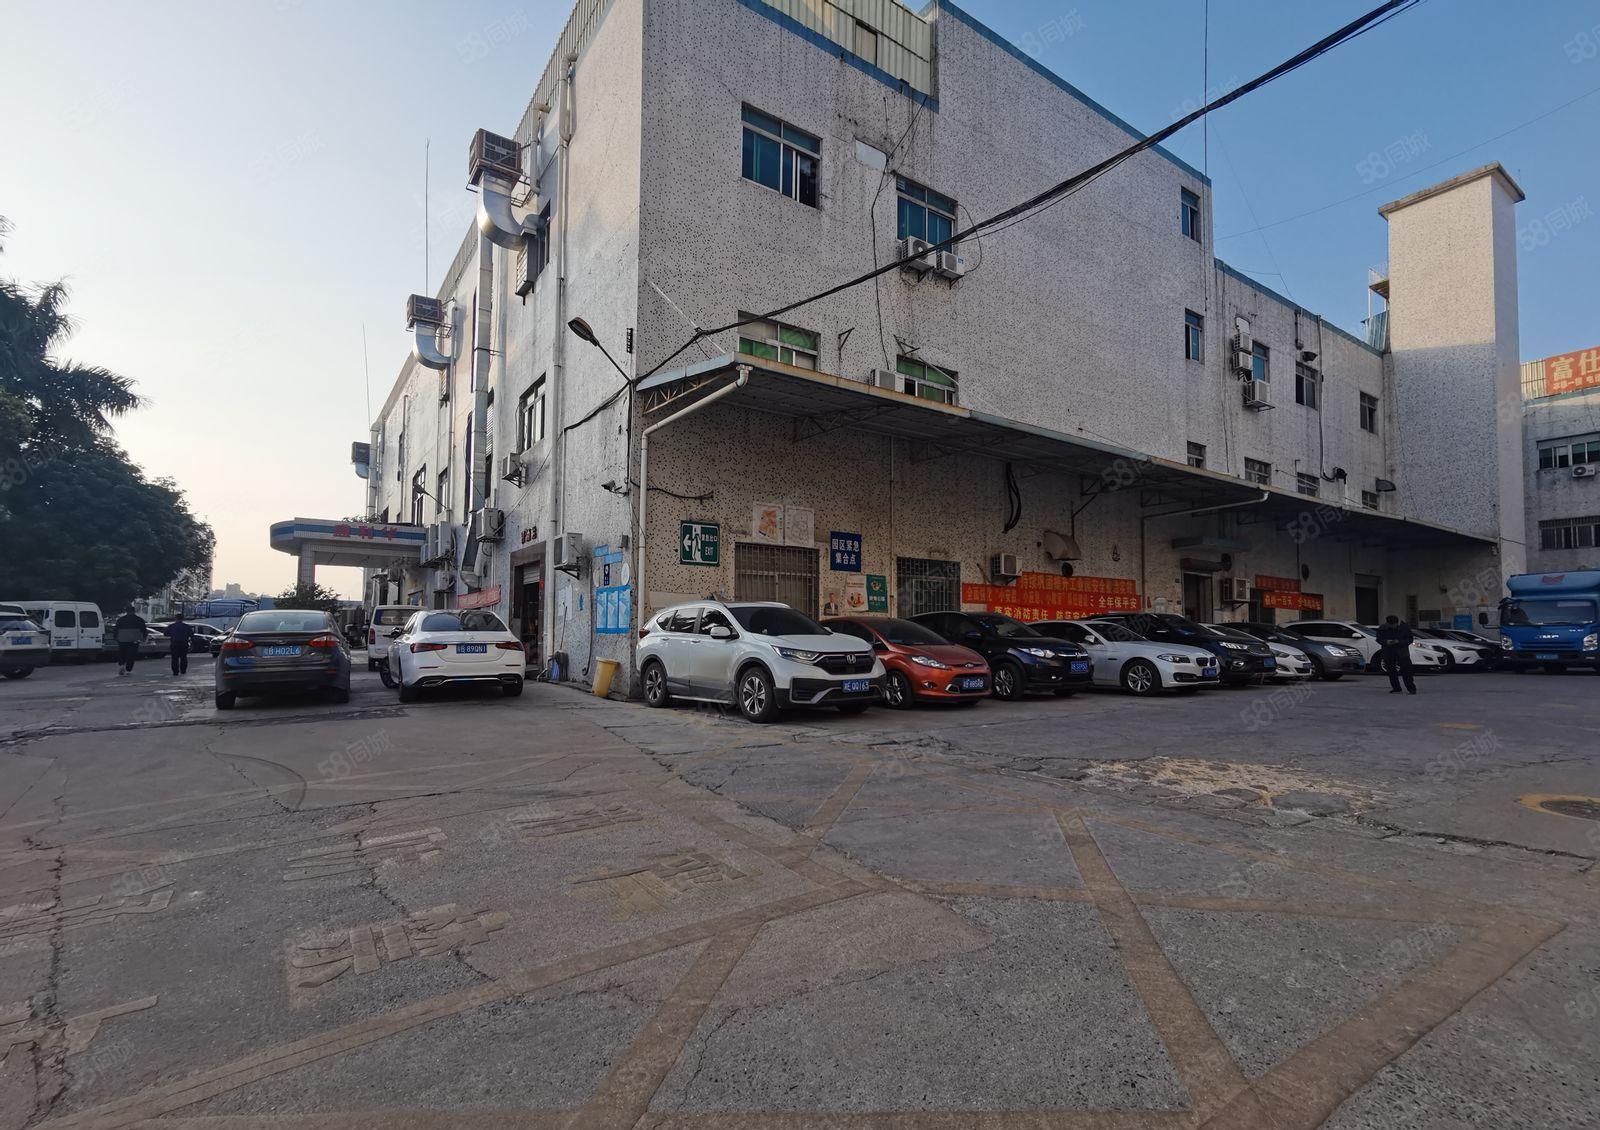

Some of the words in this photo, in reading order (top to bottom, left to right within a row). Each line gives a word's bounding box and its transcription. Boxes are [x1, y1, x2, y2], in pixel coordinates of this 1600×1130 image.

[832, 538, 860, 552] 园区紧急
[835, 552, 856, 565] 集合点
